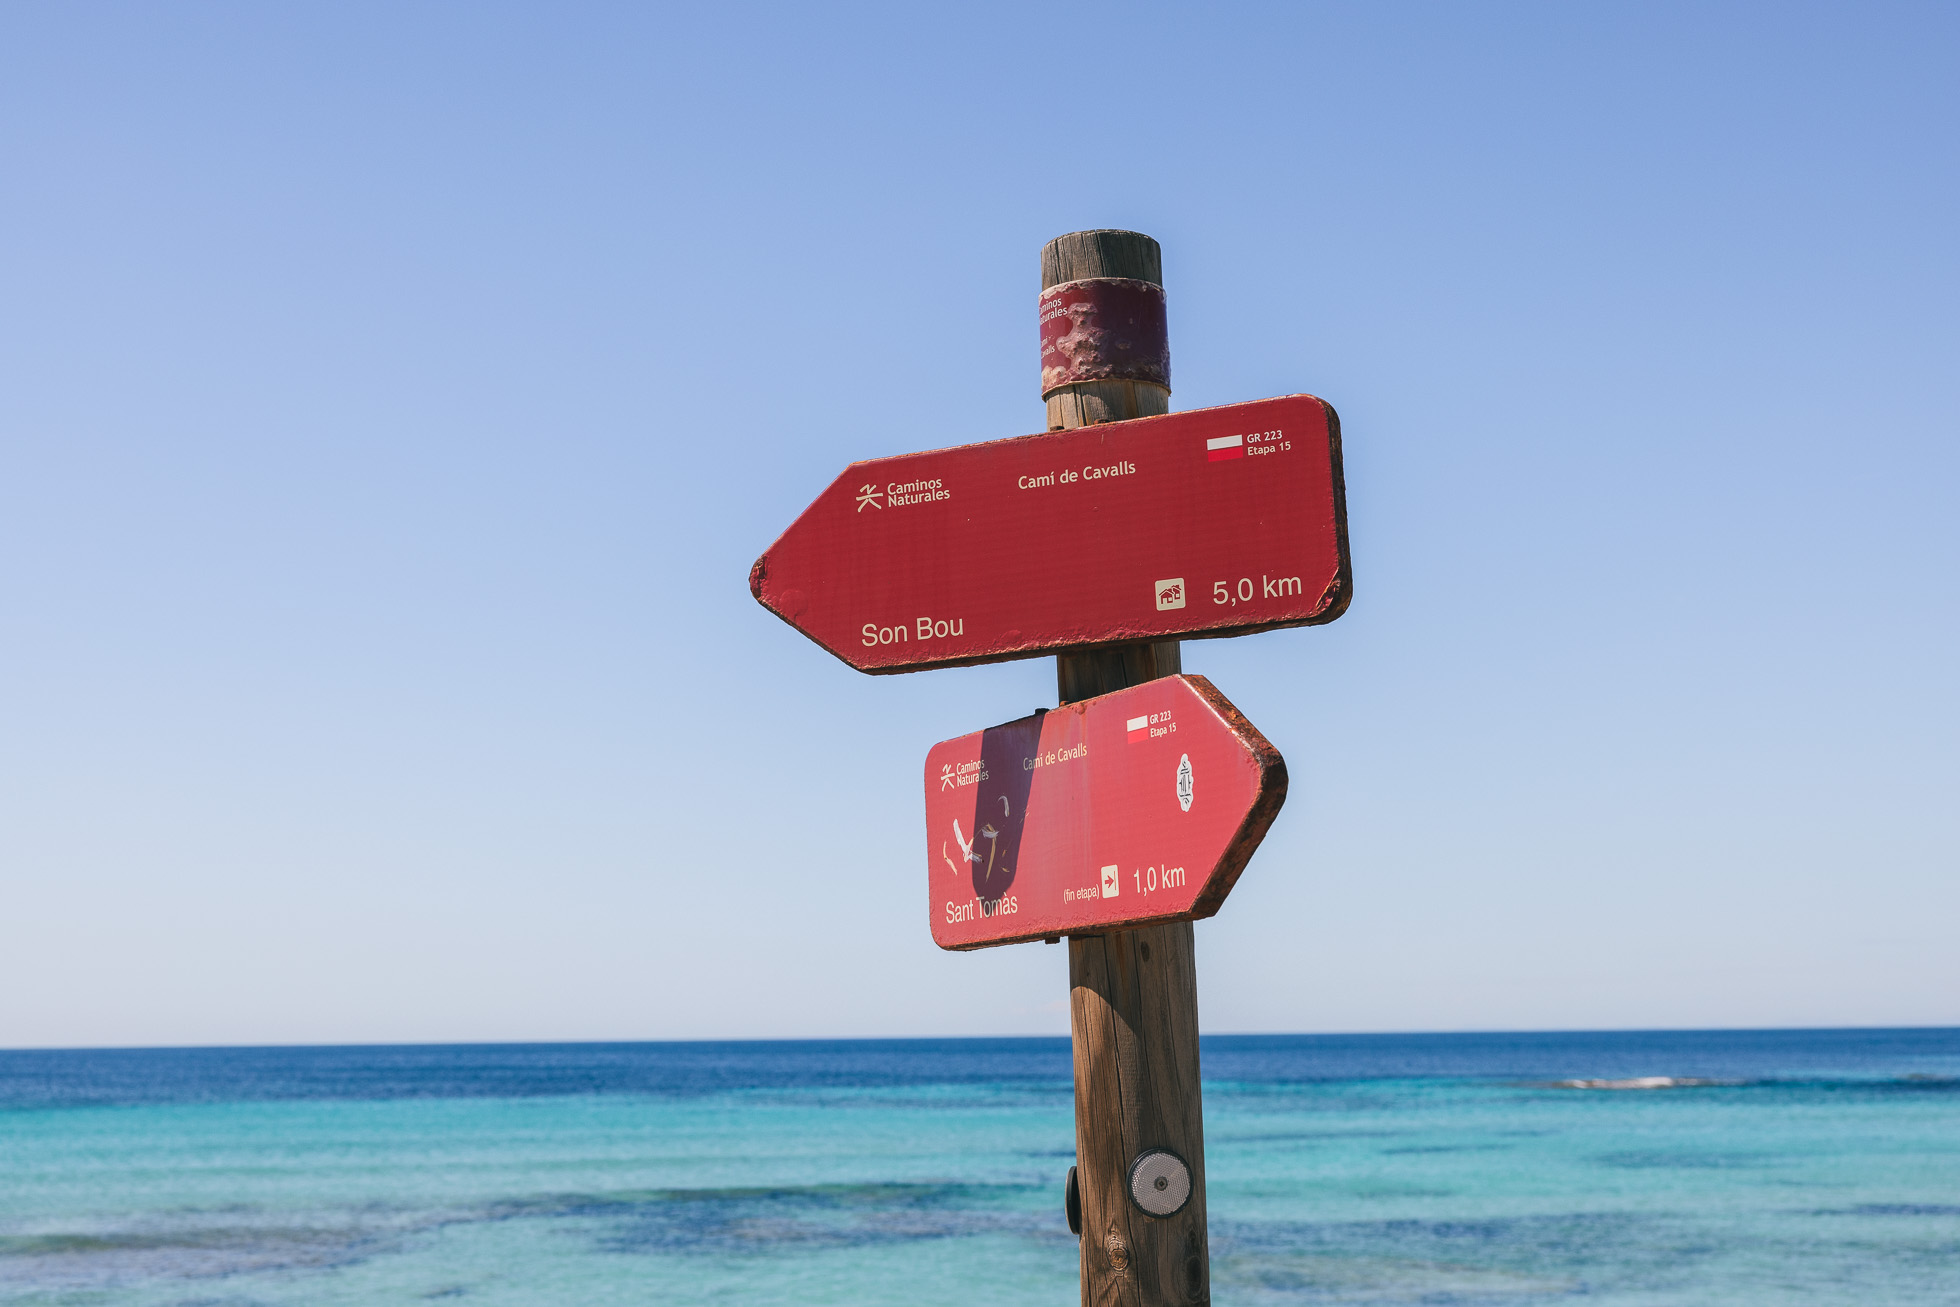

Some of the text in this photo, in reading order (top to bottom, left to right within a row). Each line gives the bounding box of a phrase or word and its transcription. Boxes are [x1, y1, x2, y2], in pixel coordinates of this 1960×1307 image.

[1247, 430, 1283, 444] GR 223
[1247, 441, 1292, 456] Etapa 15
[1018, 460, 1136, 489] Camí de Cavalls
[887, 478, 943, 495] Caminos
[888, 488, 950, 508] Naturales
[1213, 574, 1302, 607] 5,0 km
[861, 616, 964, 647] Son Bou
[1149, 710, 1172, 725] GR 223
[1149, 722, 1177, 738] Etapa 15
[956, 758, 985, 775] Caminos
[1023, 742, 1088, 771] Camí de Cavalls
[957, 769, 990, 787] Naturales
[1133, 863, 1186, 896] 1,0 km
[1063, 884, 1100, 905] (fin etapa)
[945, 892, 1019, 924] Sant Tomàs
